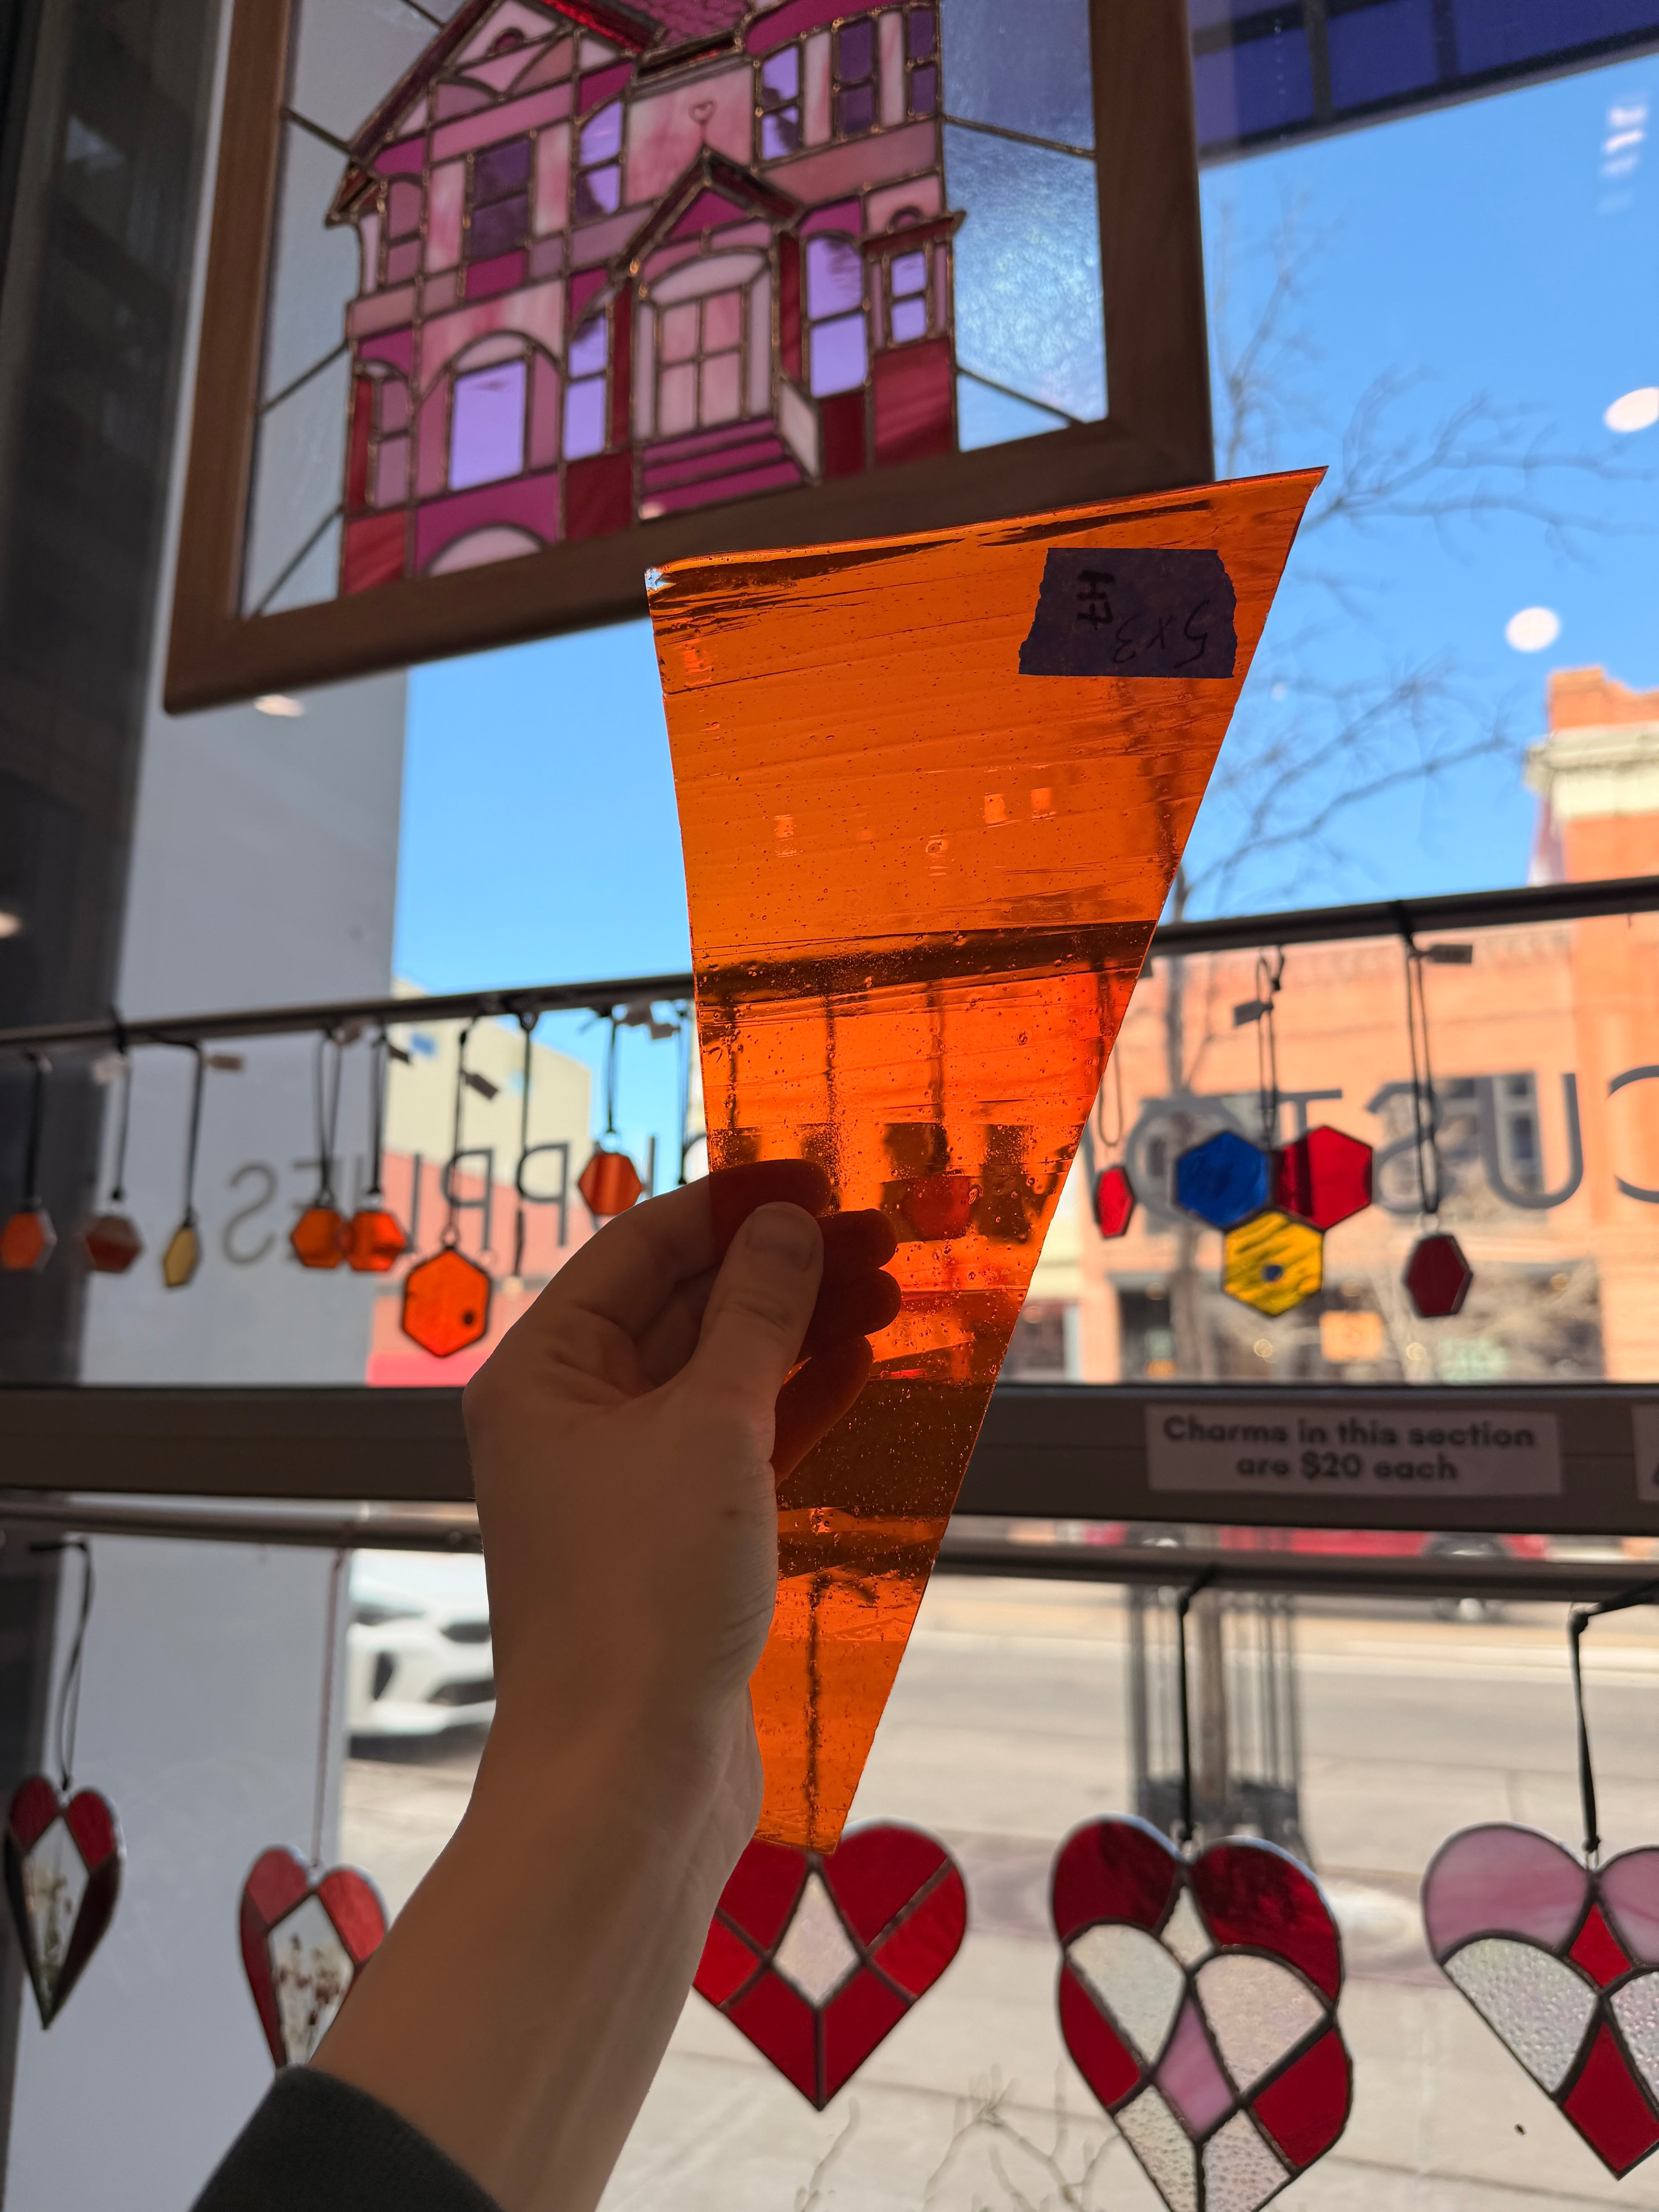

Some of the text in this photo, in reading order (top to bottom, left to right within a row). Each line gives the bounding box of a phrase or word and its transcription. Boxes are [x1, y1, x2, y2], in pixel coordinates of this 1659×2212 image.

[1163, 1415, 1535, 1448] Charms in this section
[1235, 1451, 1458, 1482] are $20 each
